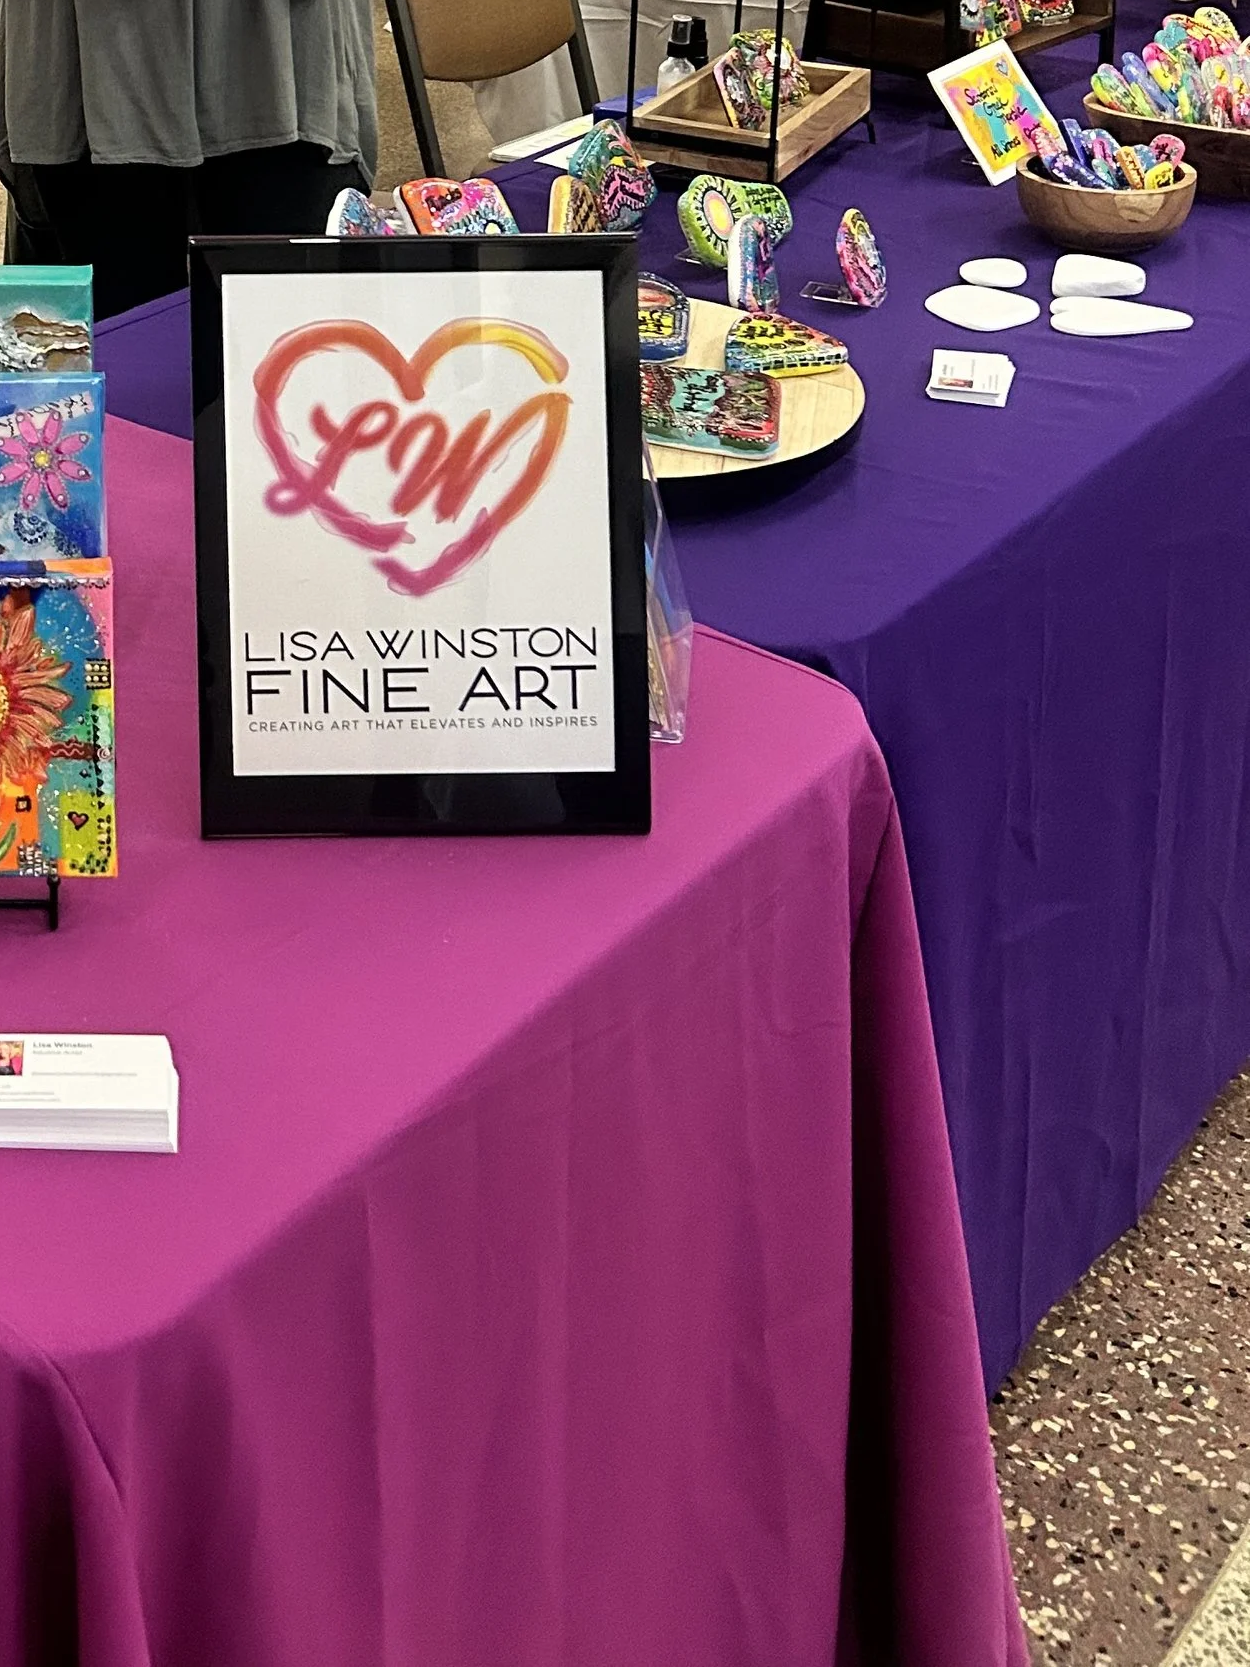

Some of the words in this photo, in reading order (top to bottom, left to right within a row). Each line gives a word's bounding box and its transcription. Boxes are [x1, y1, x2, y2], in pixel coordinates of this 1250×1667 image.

[245, 631, 355, 662] LISA
[365, 626, 598, 660] WINSTON
[246, 666, 431, 715] FINE
[458, 664, 598, 712] ART
[248, 719, 325, 733] CREATING
[330, 719, 359, 731] ART
[366, 718, 404, 731] THAT
[410, 717, 486, 730] ELEVATES
[491, 716, 524, 729] AND
[530, 715, 598, 728] INSPIRES
[33, 1041, 52, 1049] Lisa
